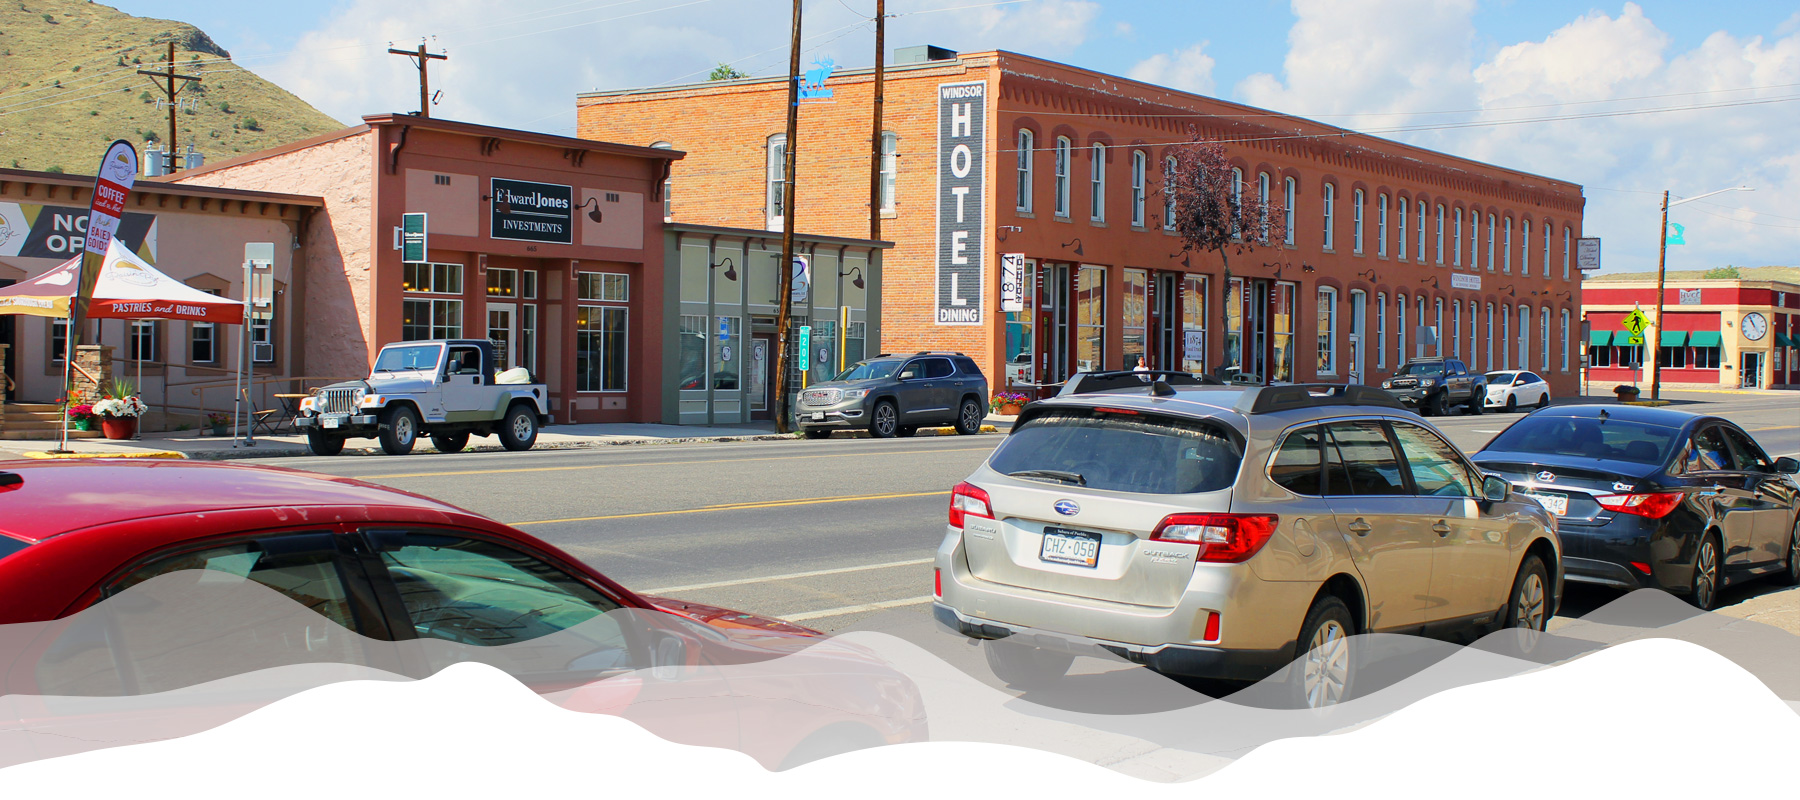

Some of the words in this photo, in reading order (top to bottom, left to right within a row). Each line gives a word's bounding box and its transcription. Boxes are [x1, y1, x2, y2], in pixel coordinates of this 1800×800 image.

[942, 85, 982, 99] WINDSOR
[98, 185, 125, 205] COFFEE
[950, 102, 972, 306] HOTEL
[53, 213, 88, 233] NO
[503, 219, 563, 234] INVESTMENTS
[1002, 255, 1016, 303] 1874
[112, 302, 152, 313] PASTRIES
[154, 304, 173, 313] and
[176, 305, 207, 317] DRINKS
[940, 309, 977, 322] DINING
[1143, 550, 1190, 559] OUTBACK
